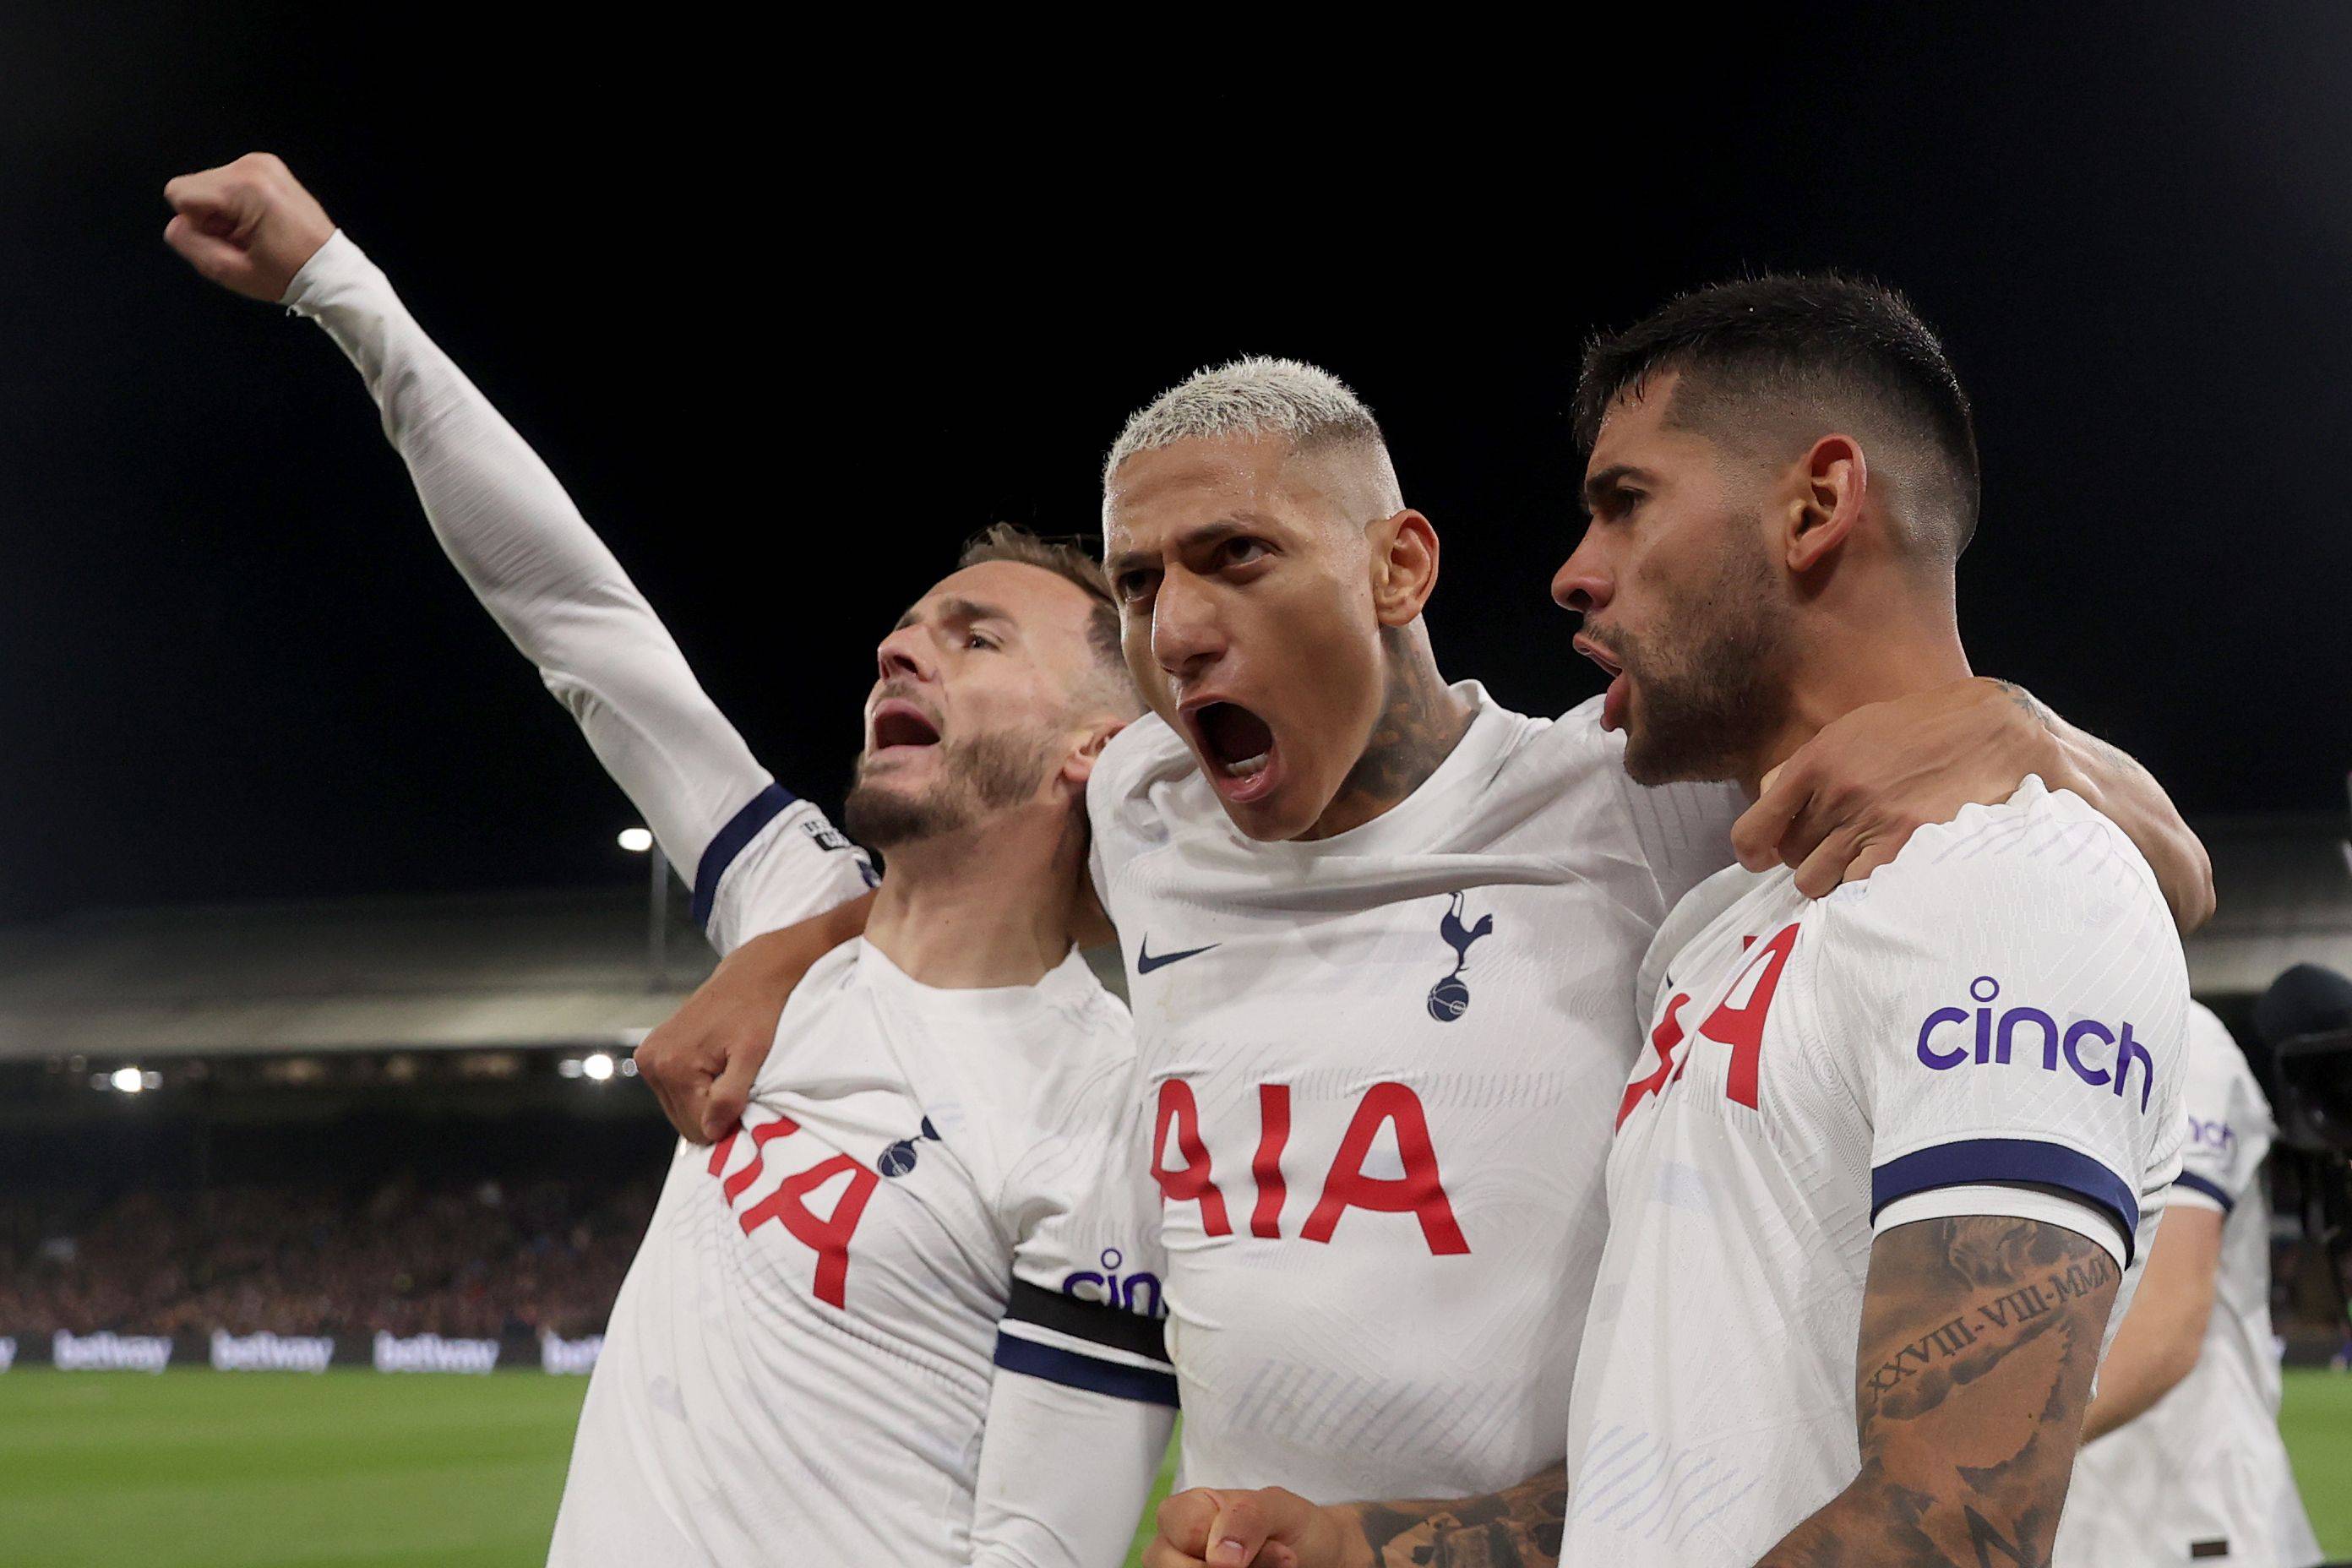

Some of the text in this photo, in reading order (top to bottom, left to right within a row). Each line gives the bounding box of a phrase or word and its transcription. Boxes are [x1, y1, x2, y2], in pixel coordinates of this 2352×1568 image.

[1917, 976, 2153, 1114] cinch
[708, 1115, 879, 1310] IA
[1151, 1079, 1471, 1255] AIA
[1063, 1249, 1161, 1319] cin
